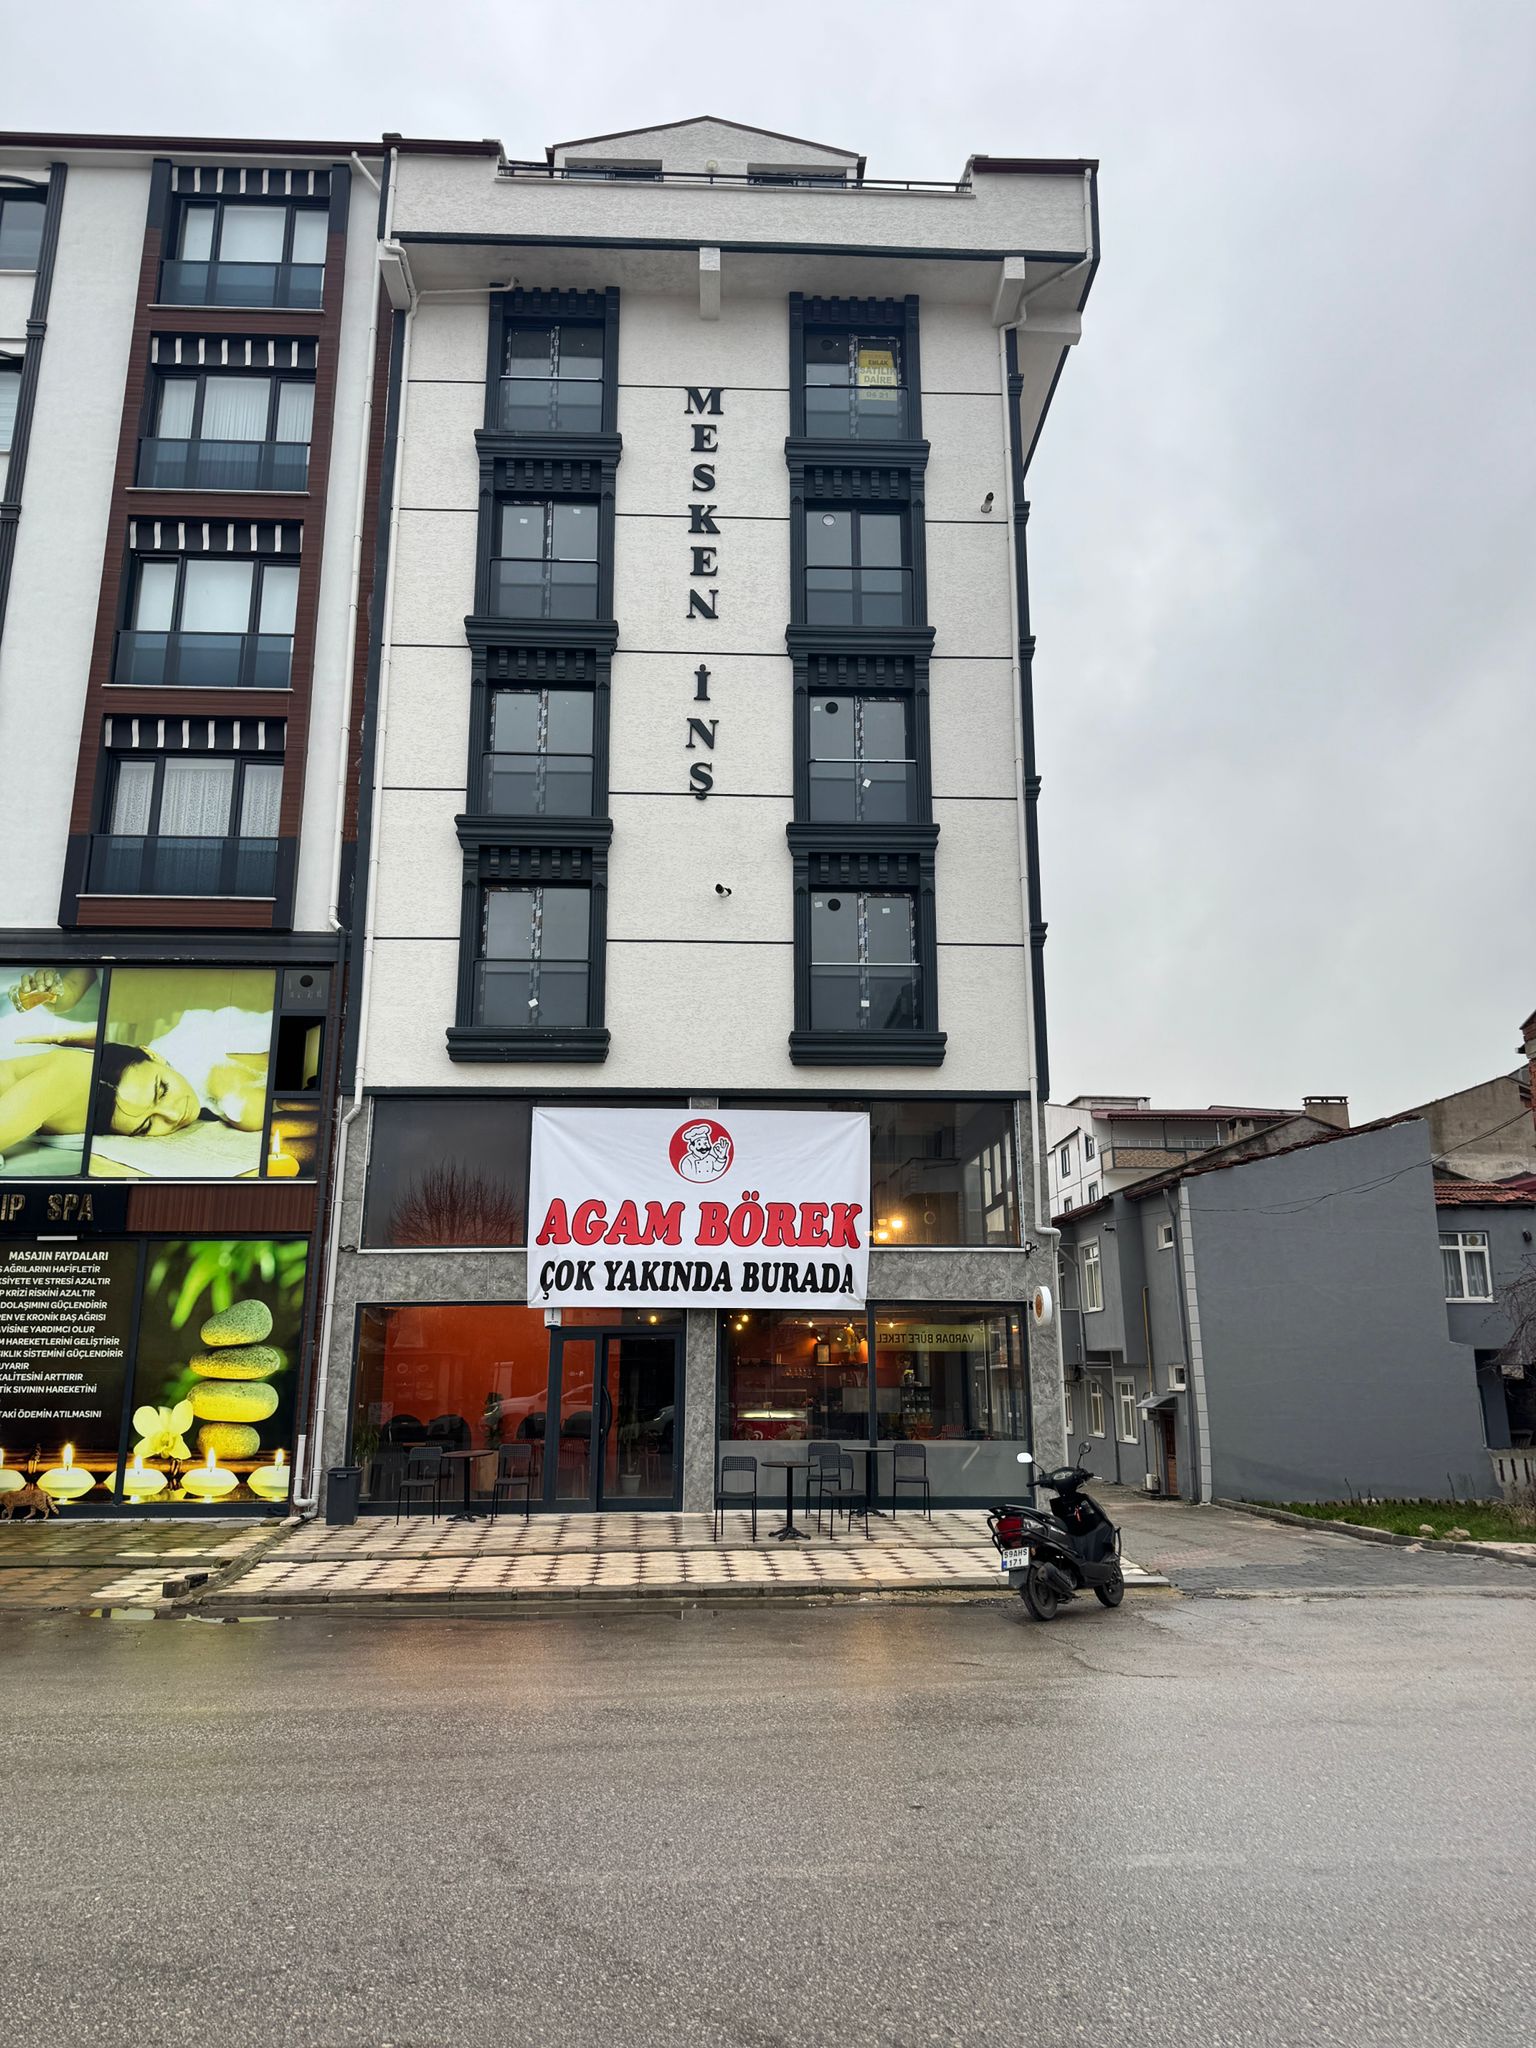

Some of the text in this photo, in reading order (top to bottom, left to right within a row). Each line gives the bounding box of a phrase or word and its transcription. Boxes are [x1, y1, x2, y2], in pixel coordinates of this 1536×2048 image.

[864, 373, 892, 384] DAİRE
[684, 387, 724, 801] MESKEN İNŞ
[47, 1194, 94, 1221] SPA
[536, 1190, 863, 1249] AGAM BÖREK
[9, 1251, 109, 1261] MASAJIN FAYDALARI
[4, 1263, 52, 1273] AĞRILARINI
[52, 1263, 101, 1273] HAFİFLETİR
[32, 1277, 44, 1285] VE
[45, 1275, 74, 1285] STRESİ
[74, 1277, 111, 1285] AZALTIR
[539, 1259, 854, 1300] ÇOK YAKINDA BURADA
[5, 1287, 28, 1297] KRİZİ
[28, 1287, 59, 1297] RİSKİNİ
[59, 1289, 96, 1297] AZALTIR
[0, 1299, 108, 1311] DOLAŞIMINI GÜÇLENDİRİR
[0, 1311, 107, 1323] EN VE KRONİK BAŞ AĞRISI
[0, 1323, 96, 1333] VİSİNE YARDIMCI OLUR
[6, 1335, 73, 1346] HAREKETLERİNİ
[73, 1335, 120, 1347] GELİŞTİRİR
[0, 1347, 124, 1360] IKLIK SİSTEMİNİ GÜÇLENDİRİR
[43, 1373, 84, 1381] ARTTIRIR
[13, 1385, 45, 1394] SIVININ
[45, 1383, 98, 1394] HAREKETİNİ
[17, 1408, 53, 1418] ÖDEMİN
[53, 1410, 102, 1418] ATILMASINI
[1009, 1558, 1022, 1566] 171
